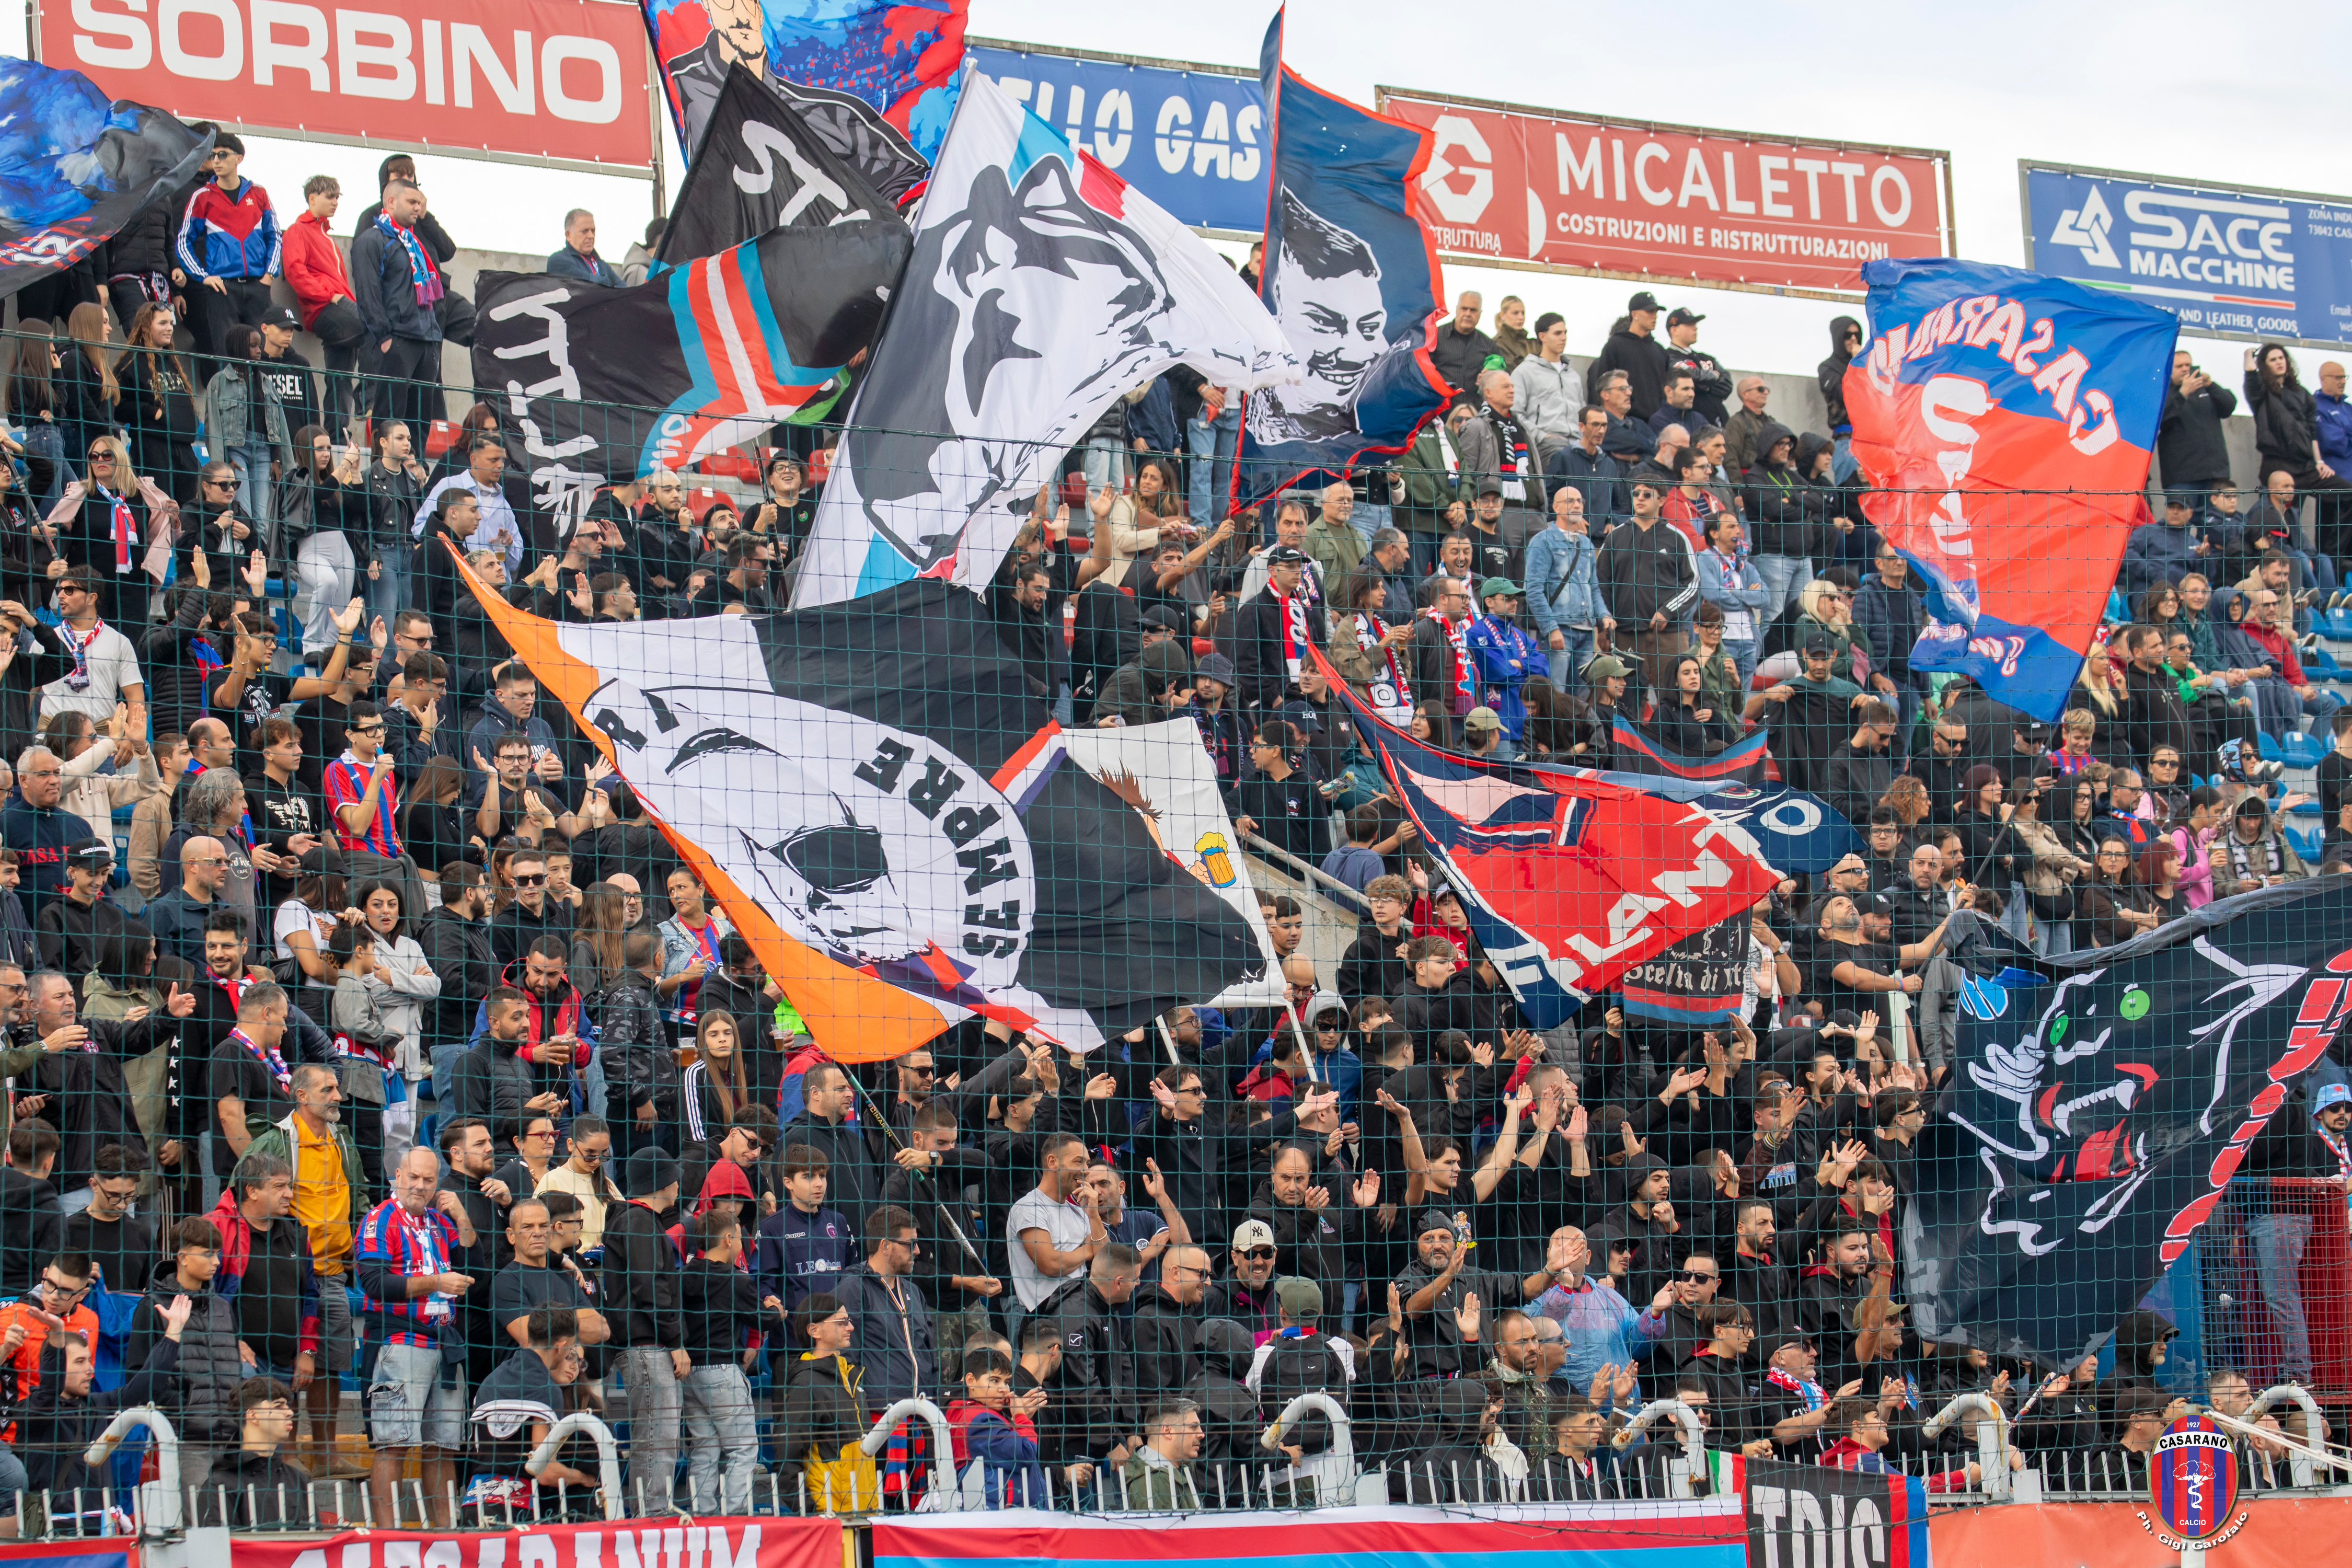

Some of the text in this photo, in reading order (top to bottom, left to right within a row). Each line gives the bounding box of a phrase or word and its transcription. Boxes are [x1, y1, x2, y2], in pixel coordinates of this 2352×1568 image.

[72, 0, 622, 123] SORBINO
[1155, 95, 1261, 181] GAS
[1555, 132, 1912, 227] MICALETTO
[1557, 212, 1889, 260] COSTRUZIONI E RISTRUTTURAZIONI
[2124, 190, 2294, 263] SACE
[2308, 209, 2333, 221] ZONA
[2308, 224, 2333, 236] 73042
[2129, 249, 2295, 291] MACCHINE
[2180, 307, 2202, 322] AND
[2206, 312, 2253, 328] LEATHER
[2258, 316, 2298, 333] GOODS
[853, 736, 1020, 959] SEMPRE
